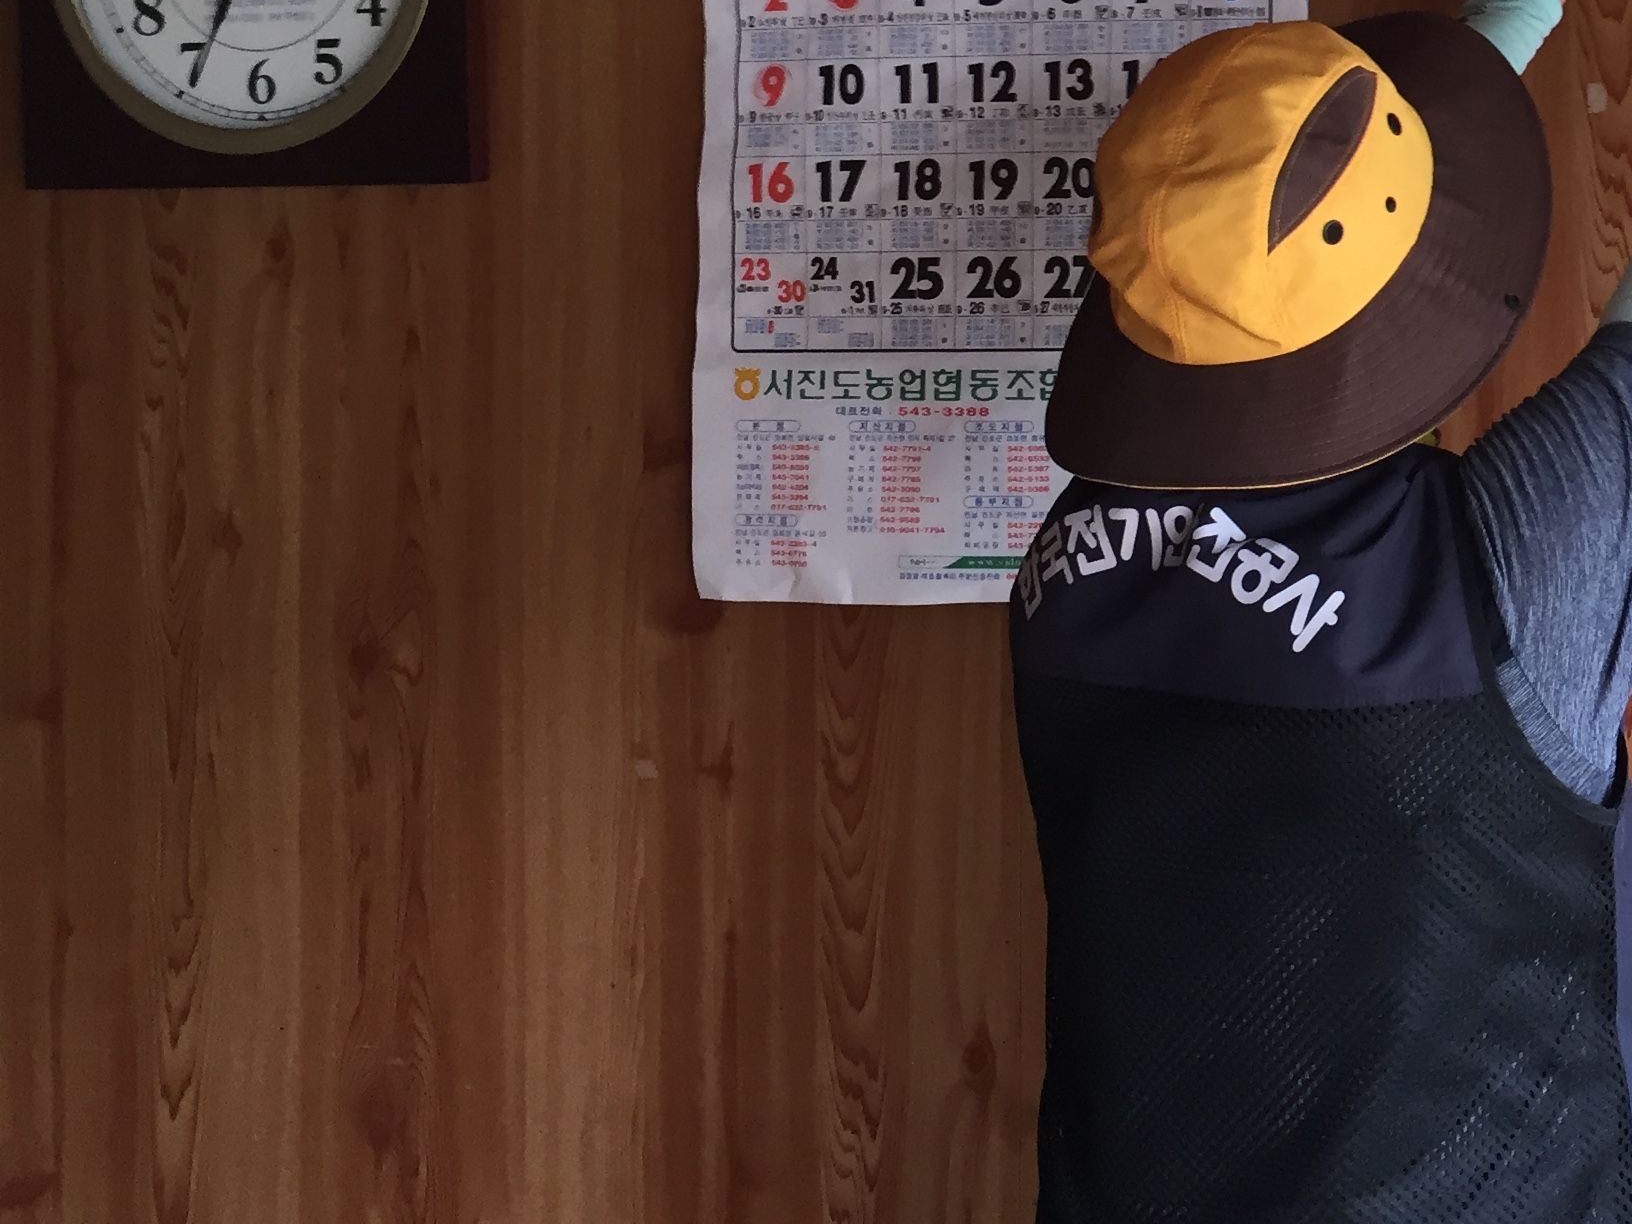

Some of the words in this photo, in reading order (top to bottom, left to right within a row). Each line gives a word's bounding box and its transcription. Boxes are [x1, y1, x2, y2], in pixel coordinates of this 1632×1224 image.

[180, 42, 208, 88] 7
[248, 59, 276, 104] 6
[314, 38, 343, 84] 5
[762, 65, 786, 107] 9
[819, 63, 865, 106] 10
[895, 62, 939, 104] 11
[968, 60, 1018, 103] 12
[1045, 58, 1095, 101] 13
[747, 161, 795, 203] 16
[815, 159, 867, 203] 17
[894, 158, 942, 201] 18
[968, 158, 1019, 201] 19
[1042, 157, 1095, 199] 20
[740, 257, 772, 281] 23
[810, 256, 839, 281] 24
[890, 257, 945, 300] 25
[966, 256, 1022, 299] 26
[1043, 255, 1090, 299] 27
[777, 279, 806, 303] 30
[850, 280, 876, 303] 31
[898, 406, 989, 417] 543-3388
